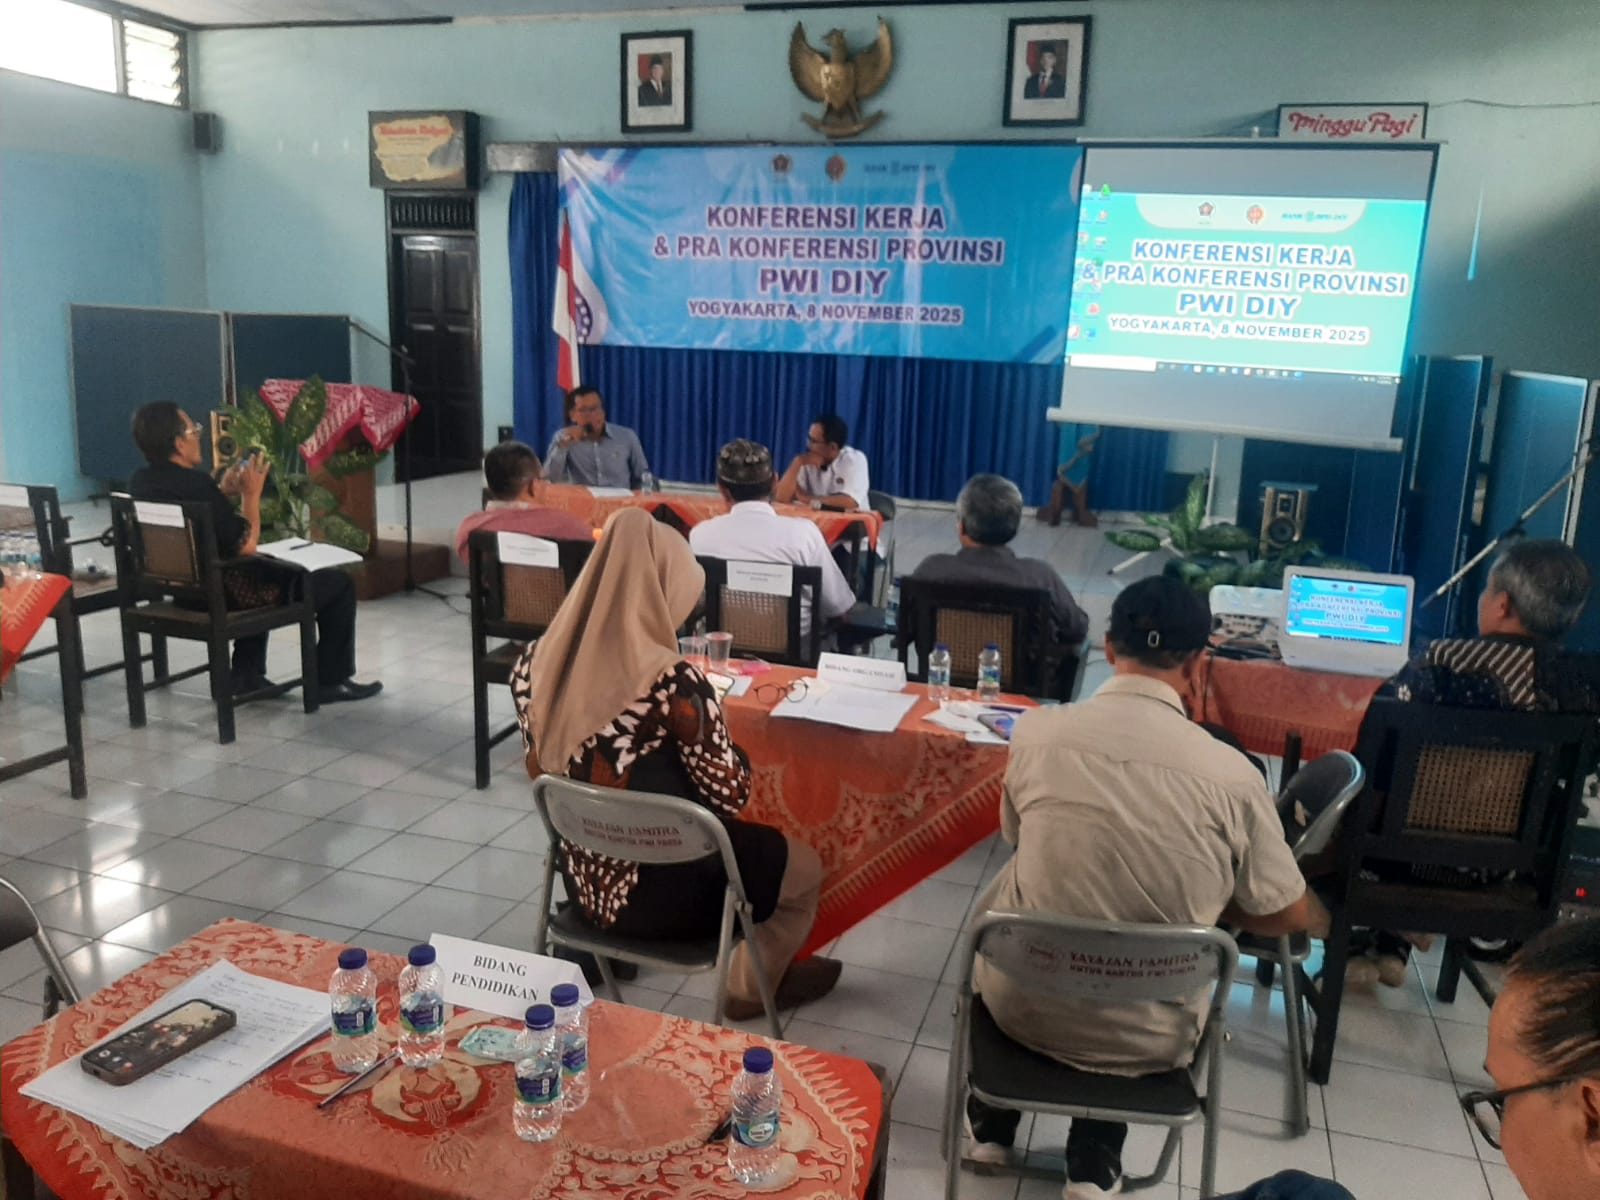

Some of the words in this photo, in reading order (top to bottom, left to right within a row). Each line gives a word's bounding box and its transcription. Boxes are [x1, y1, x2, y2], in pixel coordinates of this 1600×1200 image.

[1368, 112, 1418, 138] Pagi
[707, 206, 856, 229] KONFERENSI
[865, 206, 944, 229] KERJA
[654, 235, 669, 256] &
[677, 236, 721, 257] PRA
[729, 237, 878, 260] KONFERENSI
[887, 238, 1003, 262] PROVINSI
[1134, 241, 1271, 263] KONFERENSI
[1279, 247, 1353, 266] KERJA
[760, 268, 818, 293] PWI
[832, 269, 888, 295] DIY
[1082, 263, 1095, 280] &
[1104, 265, 1145, 282] PRA
[1152, 266, 1290, 289] KONFERENSI
[1299, 273, 1406, 293] PROVINSI
[688, 300, 801, 318] YOGYAKARTA,
[807, 304, 816, 318] 8
[822, 304, 914, 321] NOVEMBER
[920, 307, 961, 322] 2025
[1179, 293, 1234, 313] PWI
[1246, 296, 1298, 316] DIY
[1110, 317, 1215, 335] YOGYAKARTA,
[1221, 323, 1229, 334] 8
[1235, 324, 1323, 339] NOVEMBER
[1329, 329, 1366, 342] 2025
[473, 955, 527, 977] BIDANG
[451, 971, 540, 1001] PENDIDIKAN
